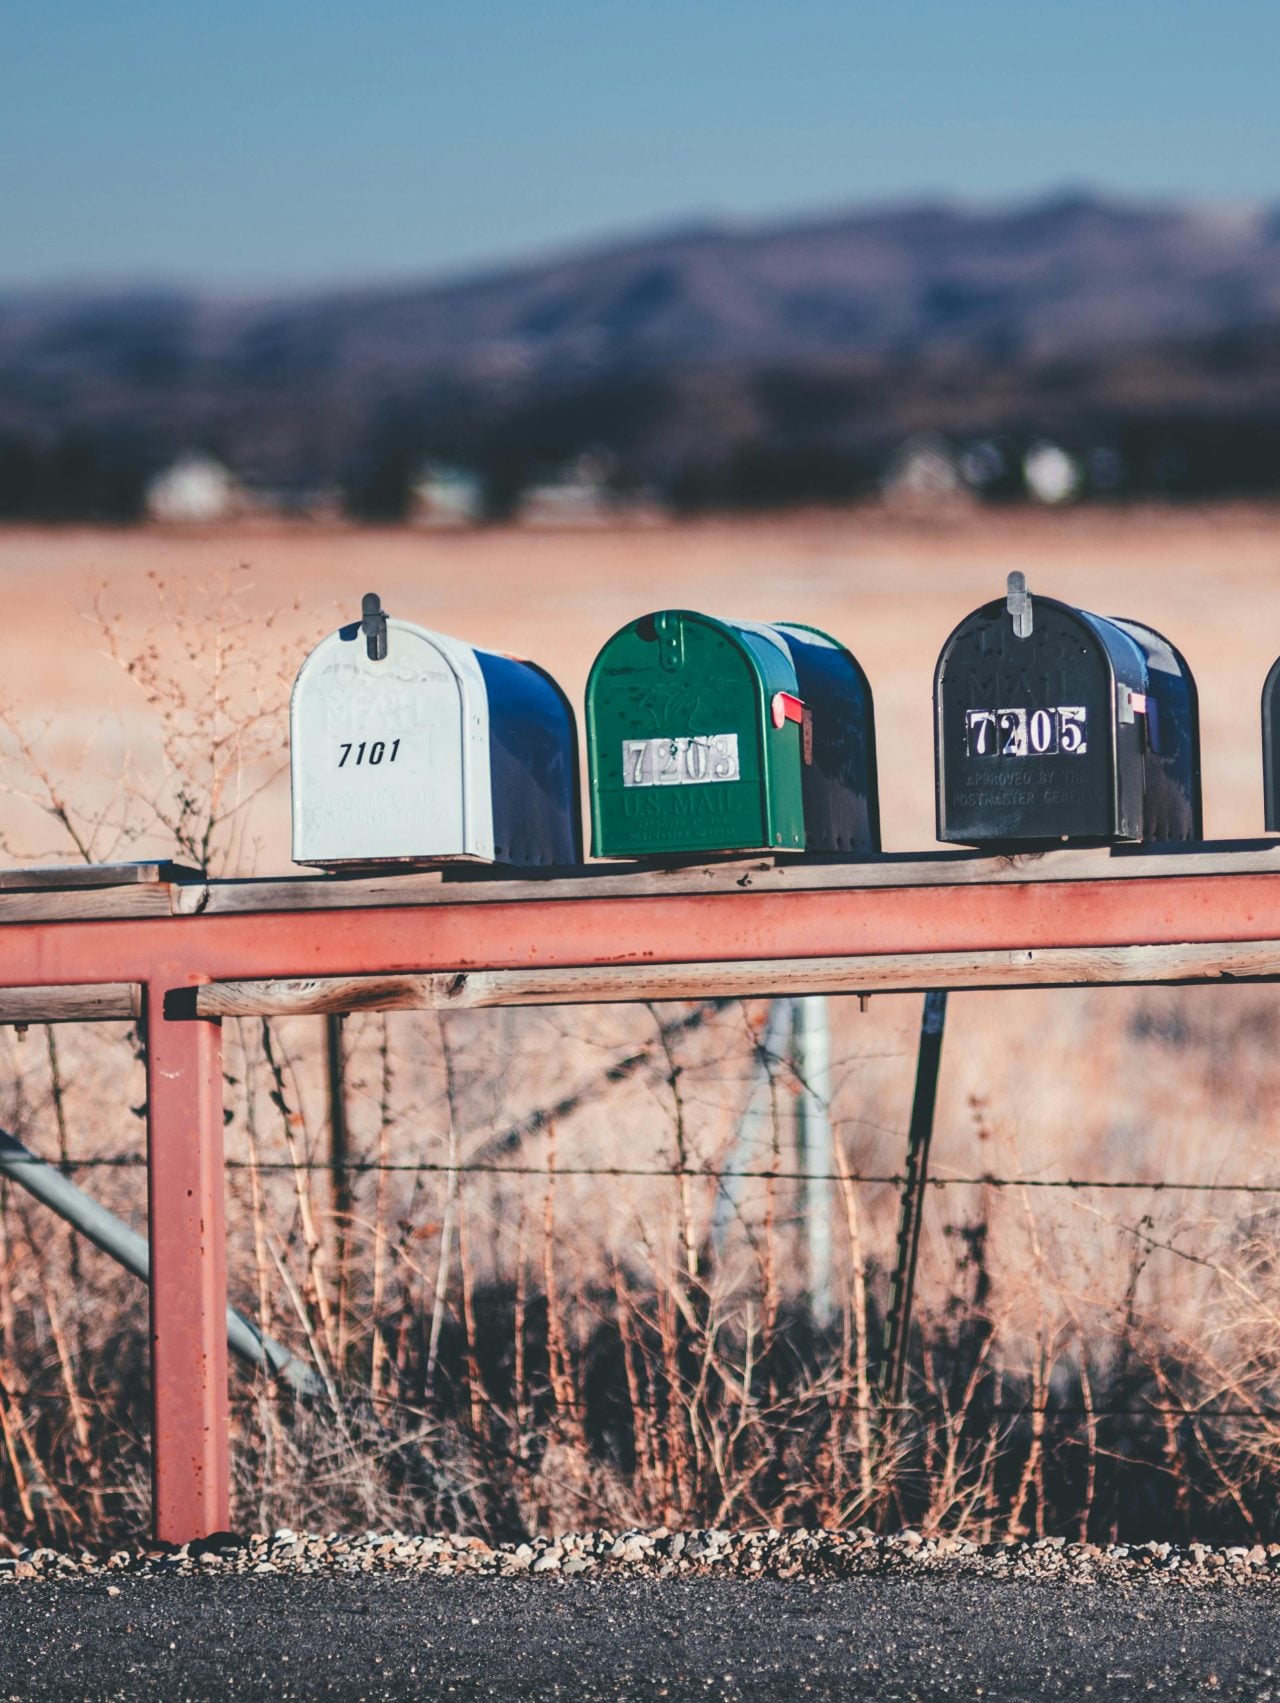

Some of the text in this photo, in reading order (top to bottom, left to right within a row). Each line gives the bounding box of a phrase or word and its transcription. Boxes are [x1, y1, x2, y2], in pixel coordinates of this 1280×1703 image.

[338, 738, 401, 768] 7101
[970, 708, 1083, 755] 7205
[627, 737, 738, 784] 7203
